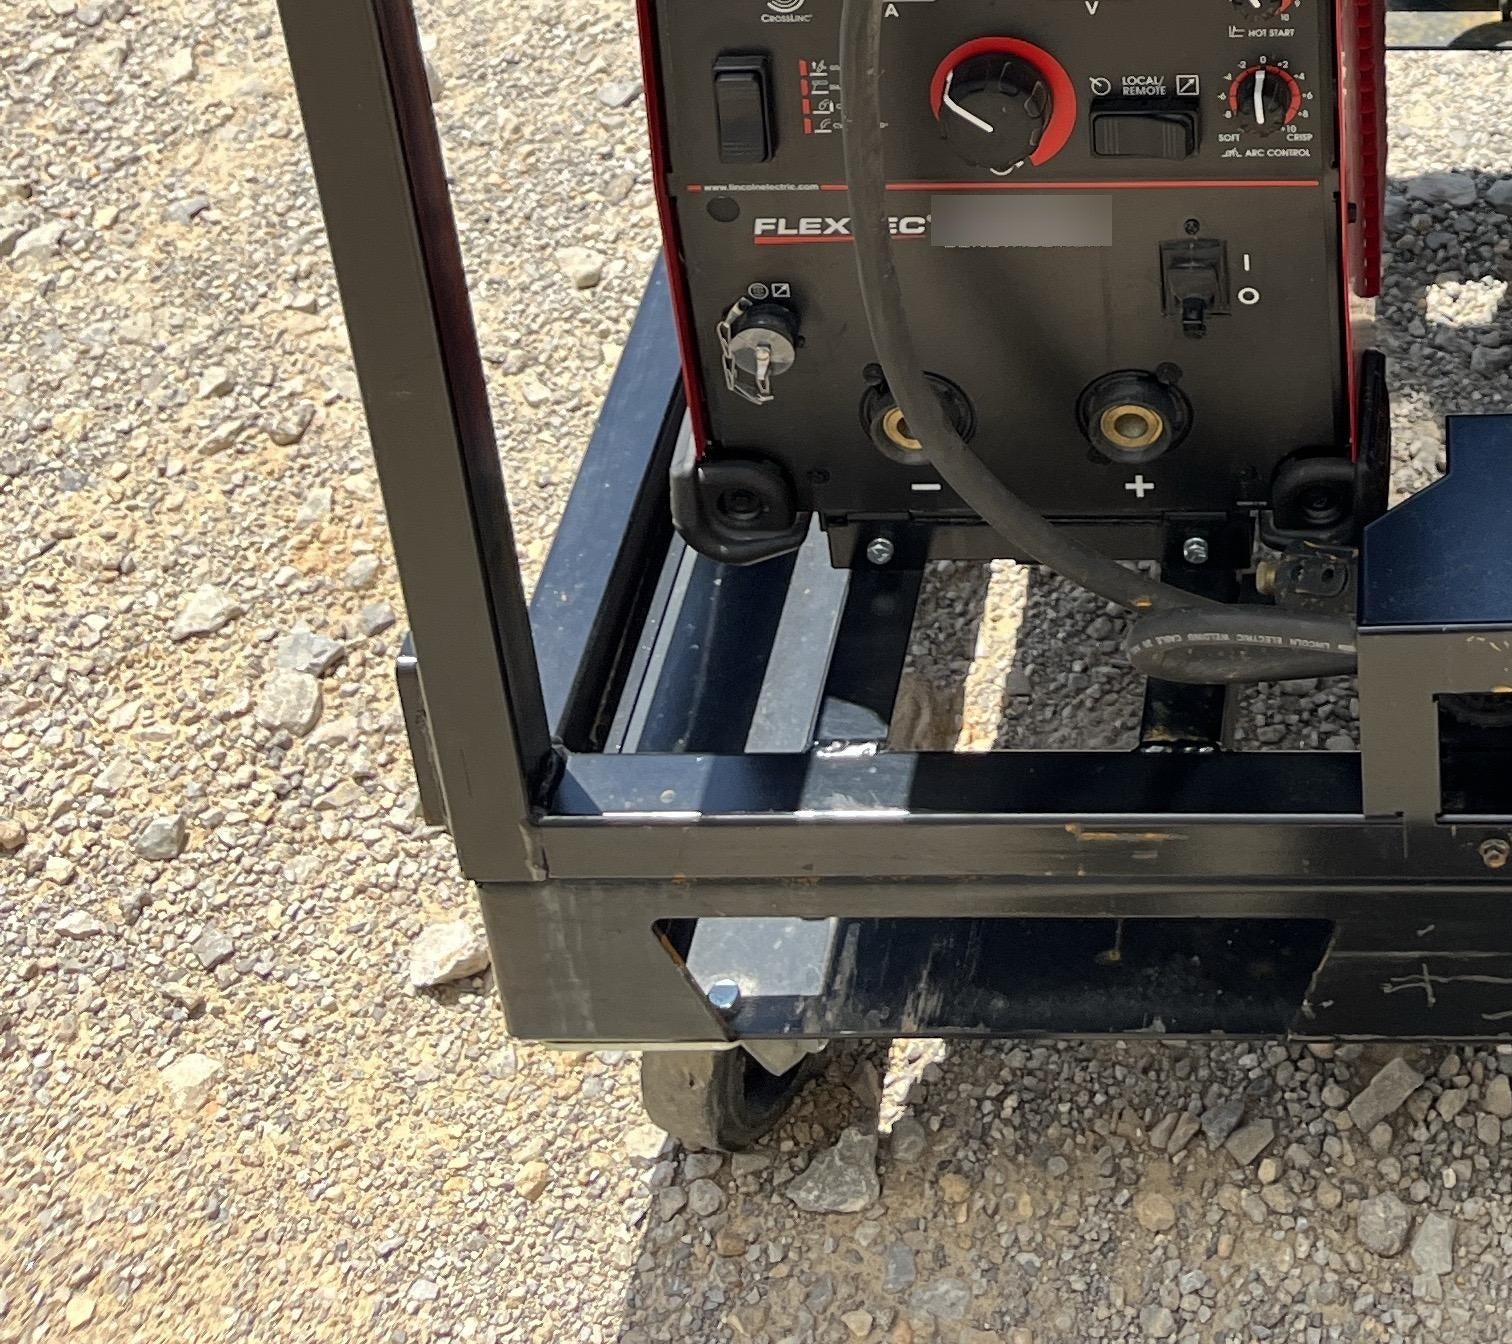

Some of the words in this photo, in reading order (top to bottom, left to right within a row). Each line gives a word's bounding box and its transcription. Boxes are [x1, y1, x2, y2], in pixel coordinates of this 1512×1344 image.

[885, 4, 899, 17] A
[1085, 1, 1098, 14] V
[1248, 29, 1266, 37] HOT
[1270, 29, 1294, 37] START
[1122, 76, 1165, 86] LOCAL/
[1123, 86, 1166, 95] REMOTE
[1219, 134, 1240, 142] SOFT
[1267, 149, 1310, 157] CONTROL
[704, 183, 819, 191] www.lincolnelectric.com
[754, 216, 925, 235] FLEXEC
